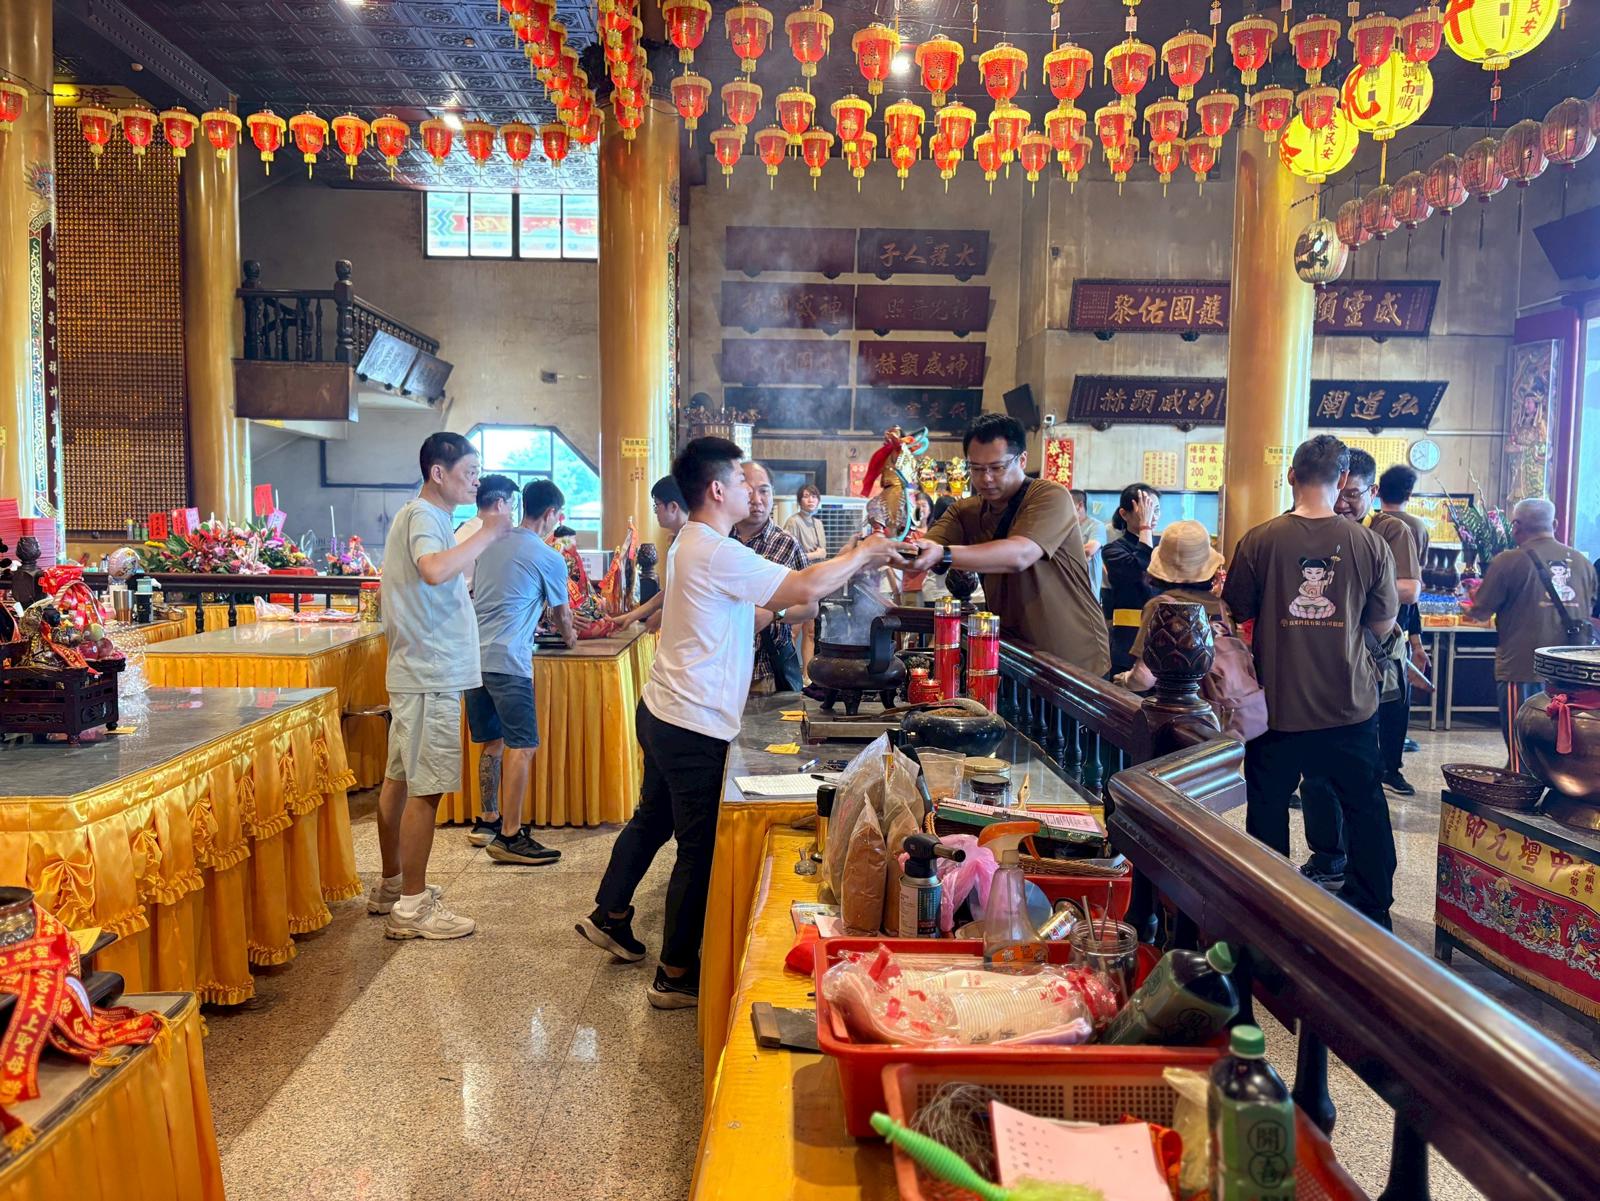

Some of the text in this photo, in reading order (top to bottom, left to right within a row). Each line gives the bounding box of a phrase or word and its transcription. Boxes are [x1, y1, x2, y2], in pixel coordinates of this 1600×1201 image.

[1396, 55, 1419, 110] 調雨順
[1320, 108, 1338, 160] 泰民安
[1191, 467, 1204, 477] 200
